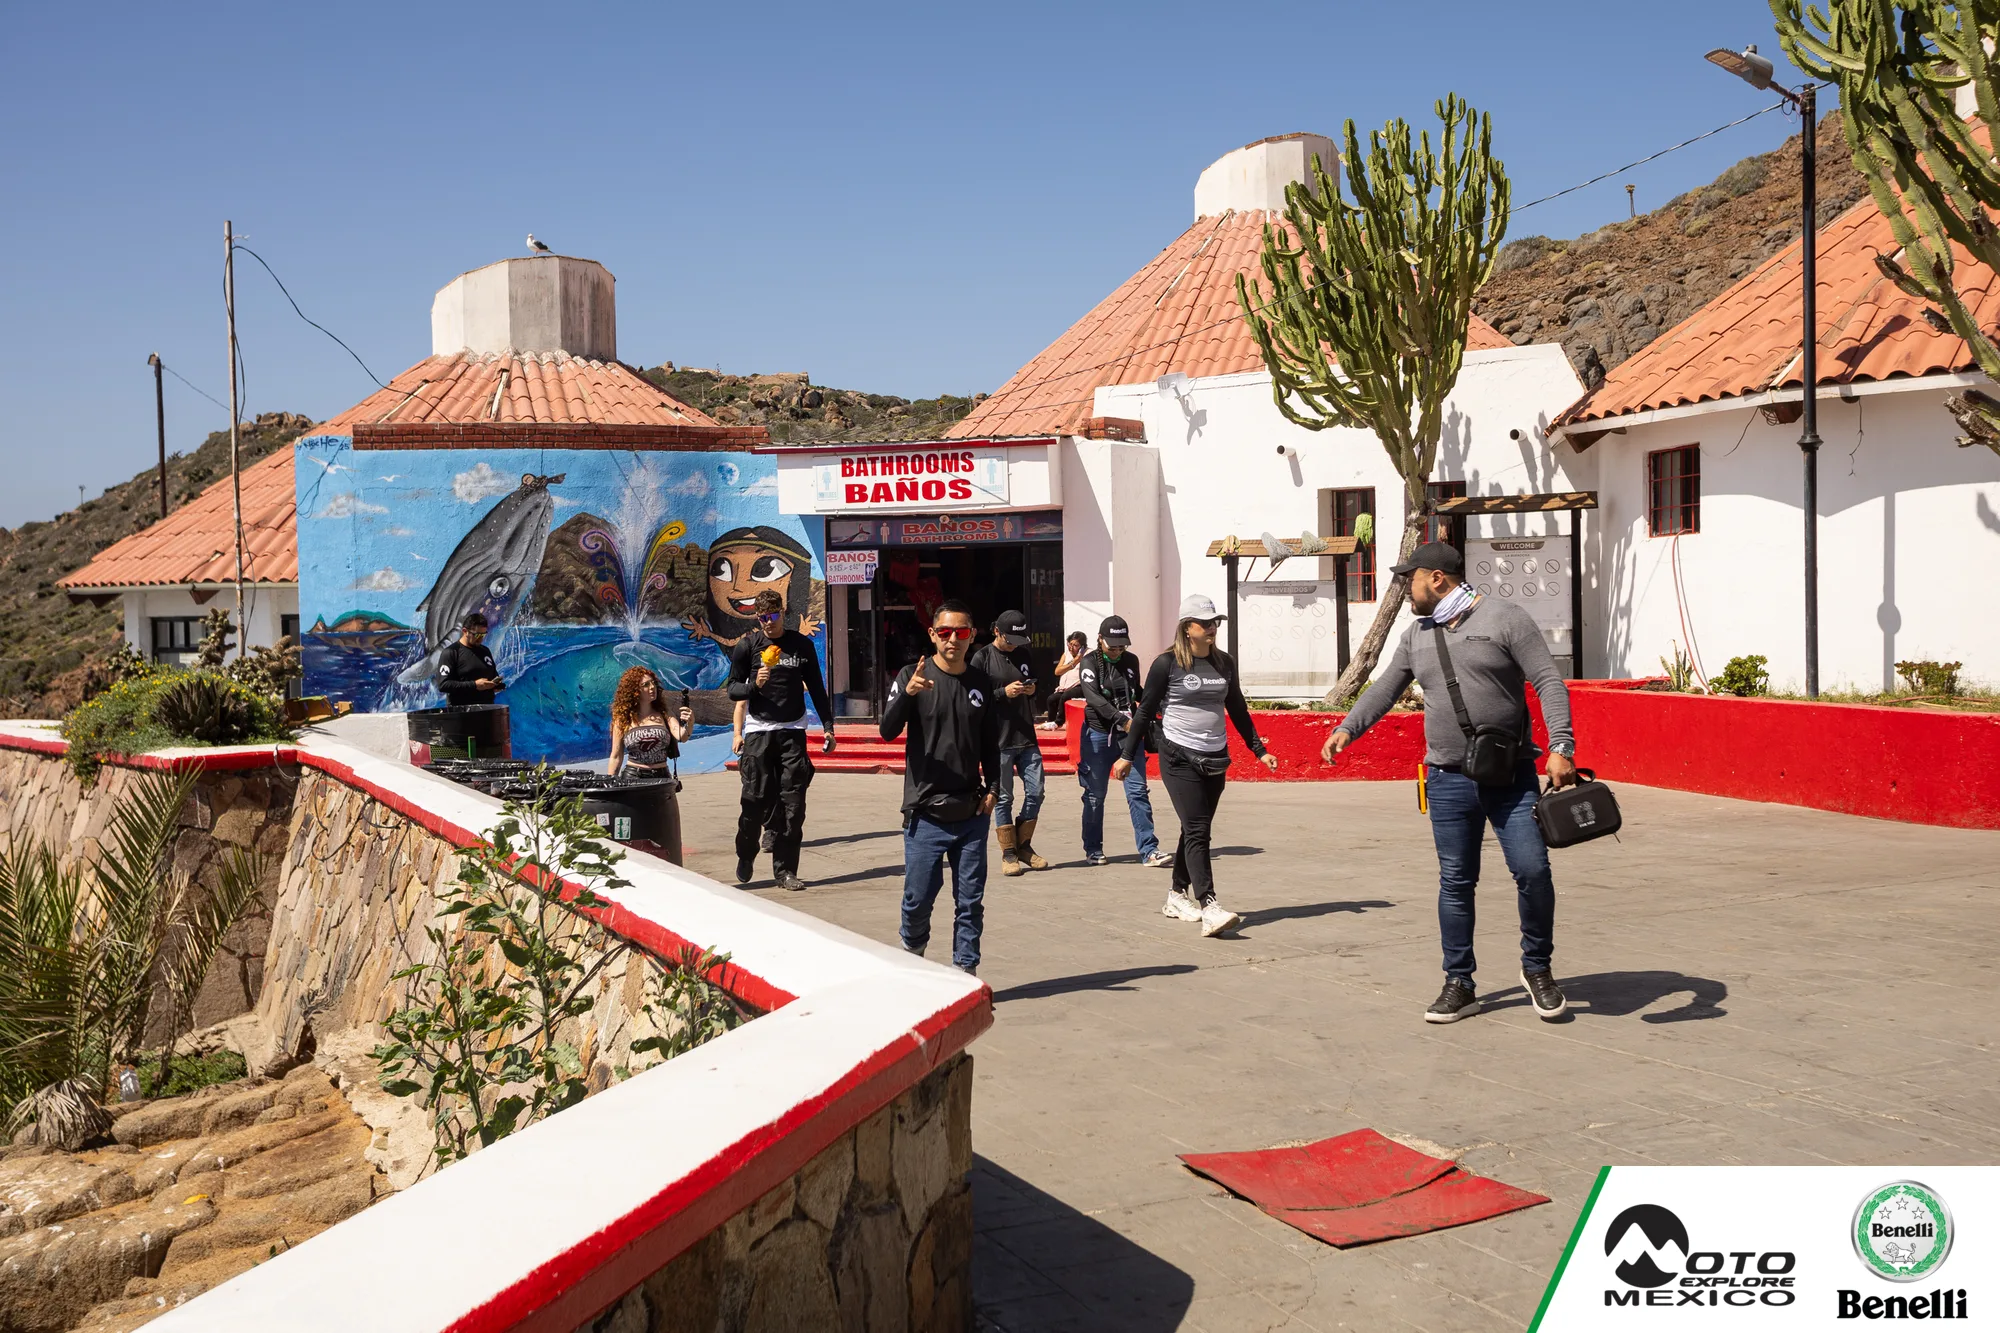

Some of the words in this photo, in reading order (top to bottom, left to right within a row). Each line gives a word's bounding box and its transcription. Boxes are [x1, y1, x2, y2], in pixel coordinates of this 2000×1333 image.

[841, 451, 975, 477] BATHROOMS
[845, 477, 972, 503] BAÑOS
[901, 532, 998, 544] BATHROOMS
[828, 552, 877, 563] BAÑOS
[828, 574, 865, 583] BATHROOMS
